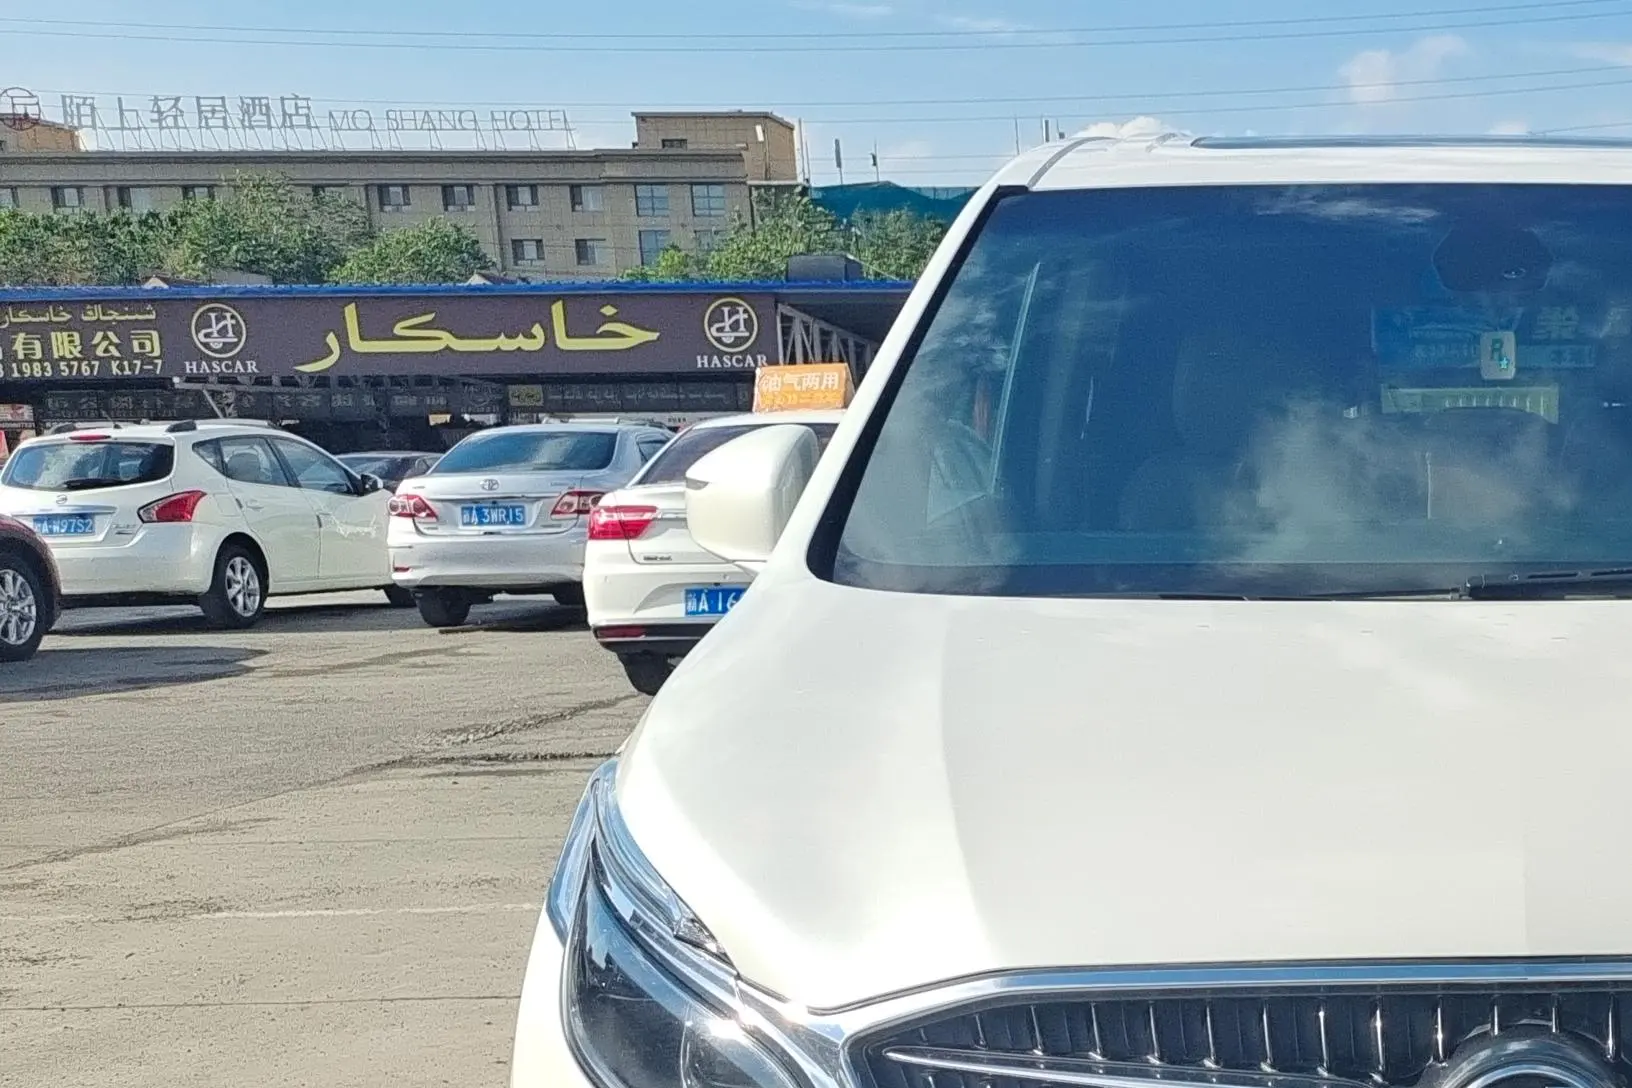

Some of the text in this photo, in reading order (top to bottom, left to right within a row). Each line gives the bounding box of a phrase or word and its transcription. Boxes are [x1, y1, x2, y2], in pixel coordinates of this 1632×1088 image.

[328, 110, 371, 131] MO
[386, 110, 477, 131] SHANG
[0, 330, 162, 360] 有限公司
[11, 361, 52, 377] 1983
[60, 361, 100, 377] 5767
[185, 361, 259, 373] HASCAR
[696, 355, 768, 369] HASCAR
